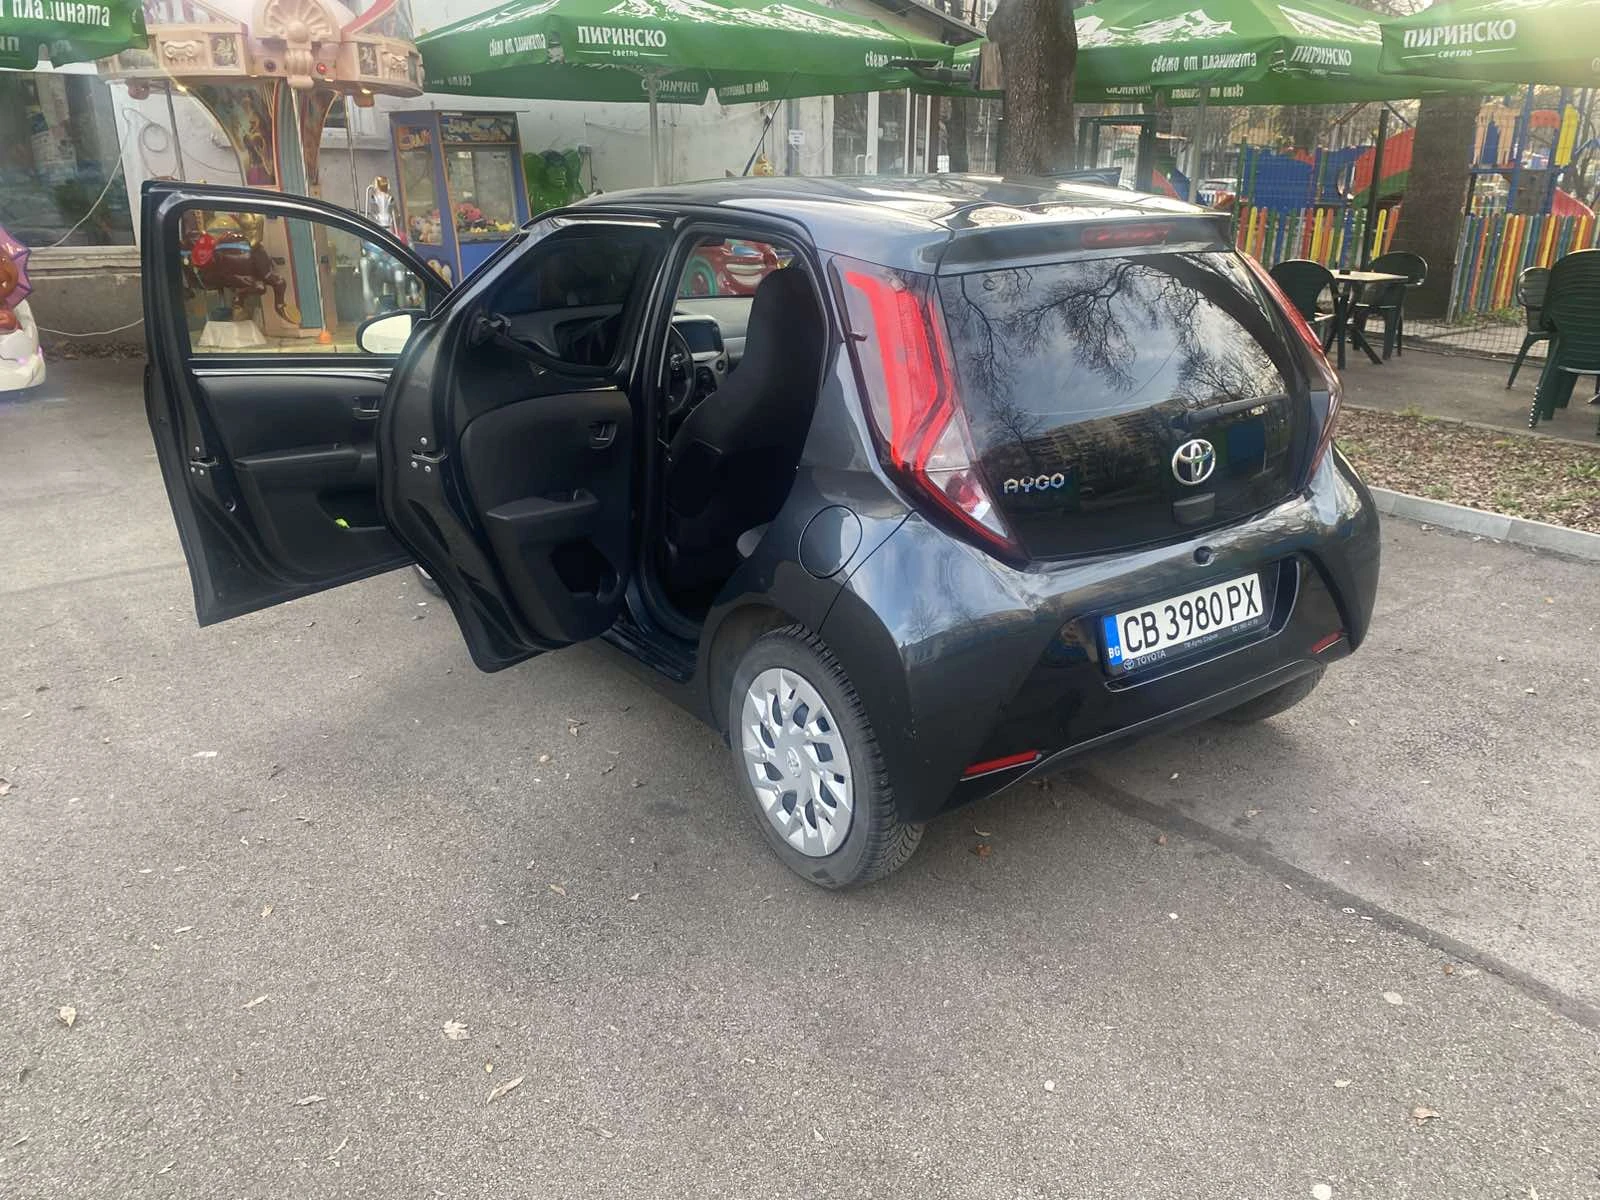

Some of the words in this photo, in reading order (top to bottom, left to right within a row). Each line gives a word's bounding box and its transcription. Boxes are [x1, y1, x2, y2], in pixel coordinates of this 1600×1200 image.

[12, 0, 111, 27] плаината
[577, 25, 667, 47] ПИРИНСКО
[1403, 18, 1517, 49] ПИРИНСКО
[612, 49, 639, 57] светло
[1151, 55, 1180, 73] свежо
[1184, 56, 1198, 71] от
[1202, 52, 1257, 70] планината
[1290, 45, 1352, 66] ПИРИНСКО
[1438, 49, 1473, 59] светло
[1003, 472, 1065, 494] AYGO
[1123, 611, 1160, 653] CB
[1164, 591, 1224, 641] 3980
[1226, 579, 1259, 622] PX
[1108, 645, 1121, 659] BG
[1136, 650, 1167, 666] TOYOTA
